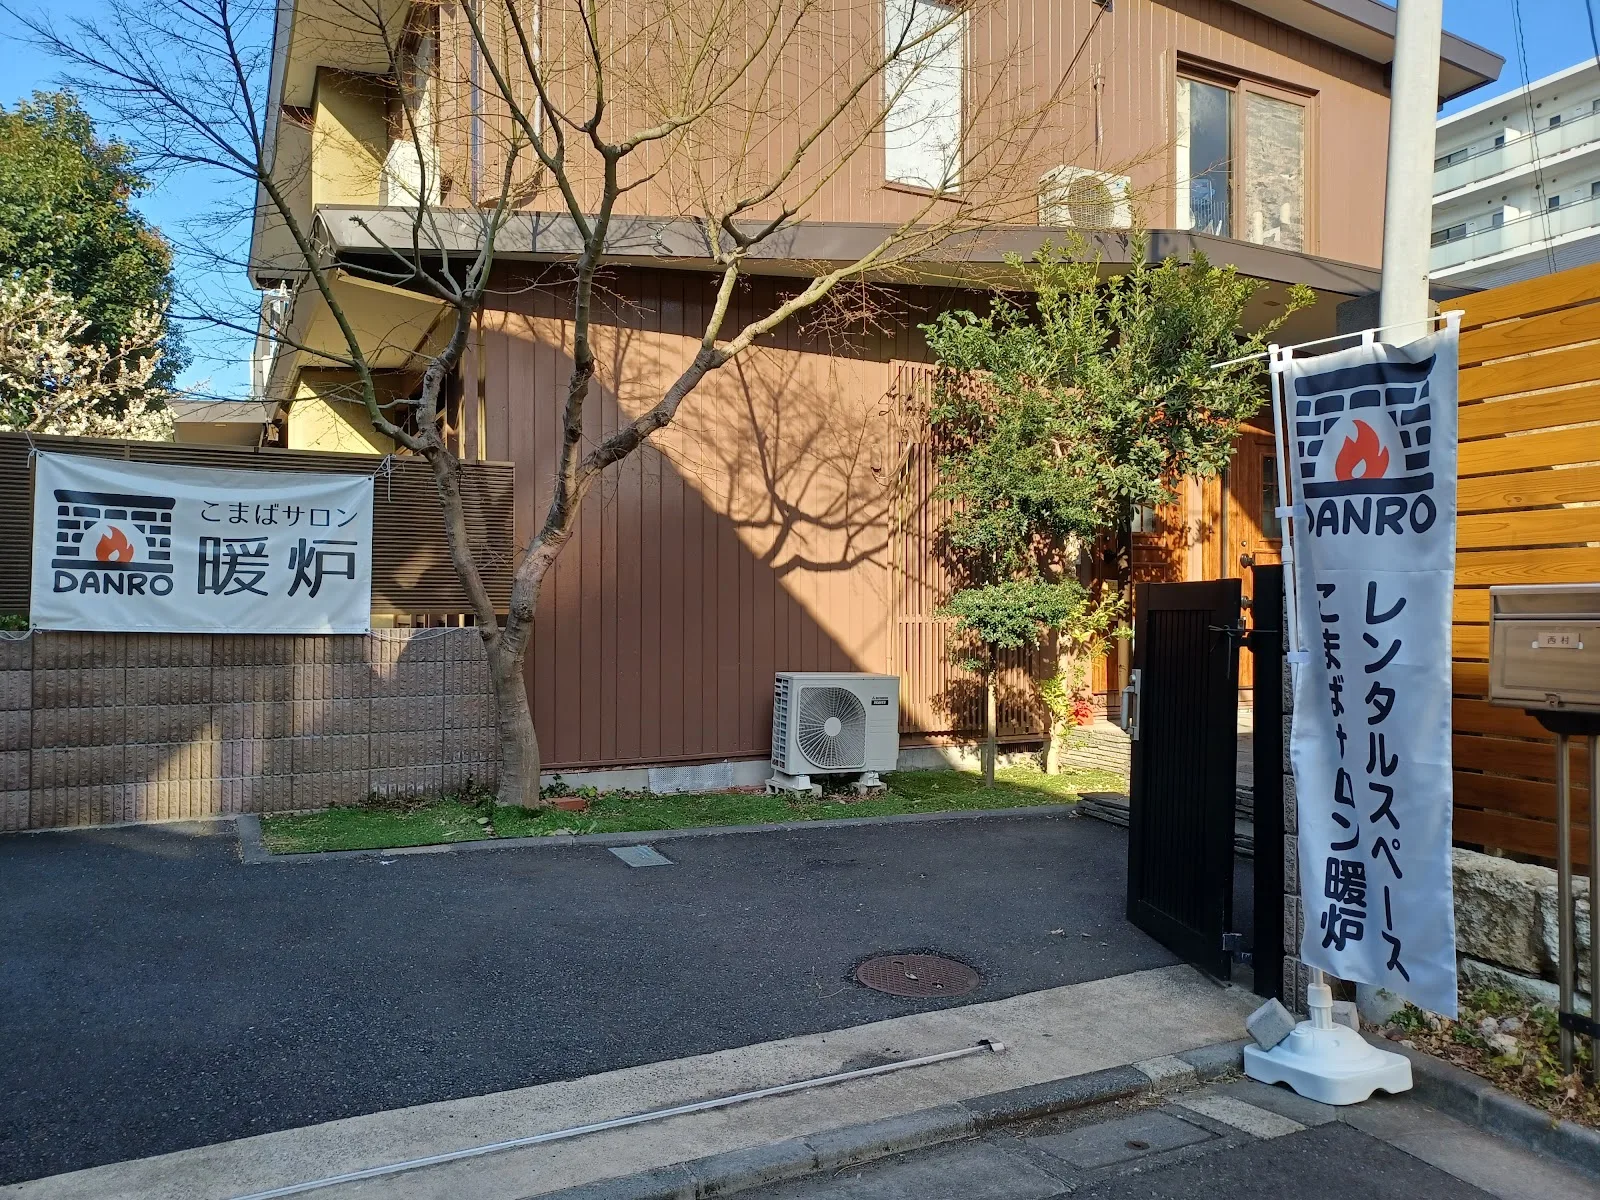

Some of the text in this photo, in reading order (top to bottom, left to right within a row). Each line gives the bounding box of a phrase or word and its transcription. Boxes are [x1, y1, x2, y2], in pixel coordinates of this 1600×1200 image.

[200, 500, 358, 527] こまばサロン
[53, 570, 174, 596] DANRO
[197, 536, 358, 598] 暖炉
[1363, 580, 1411, 983] レンタルスペース
